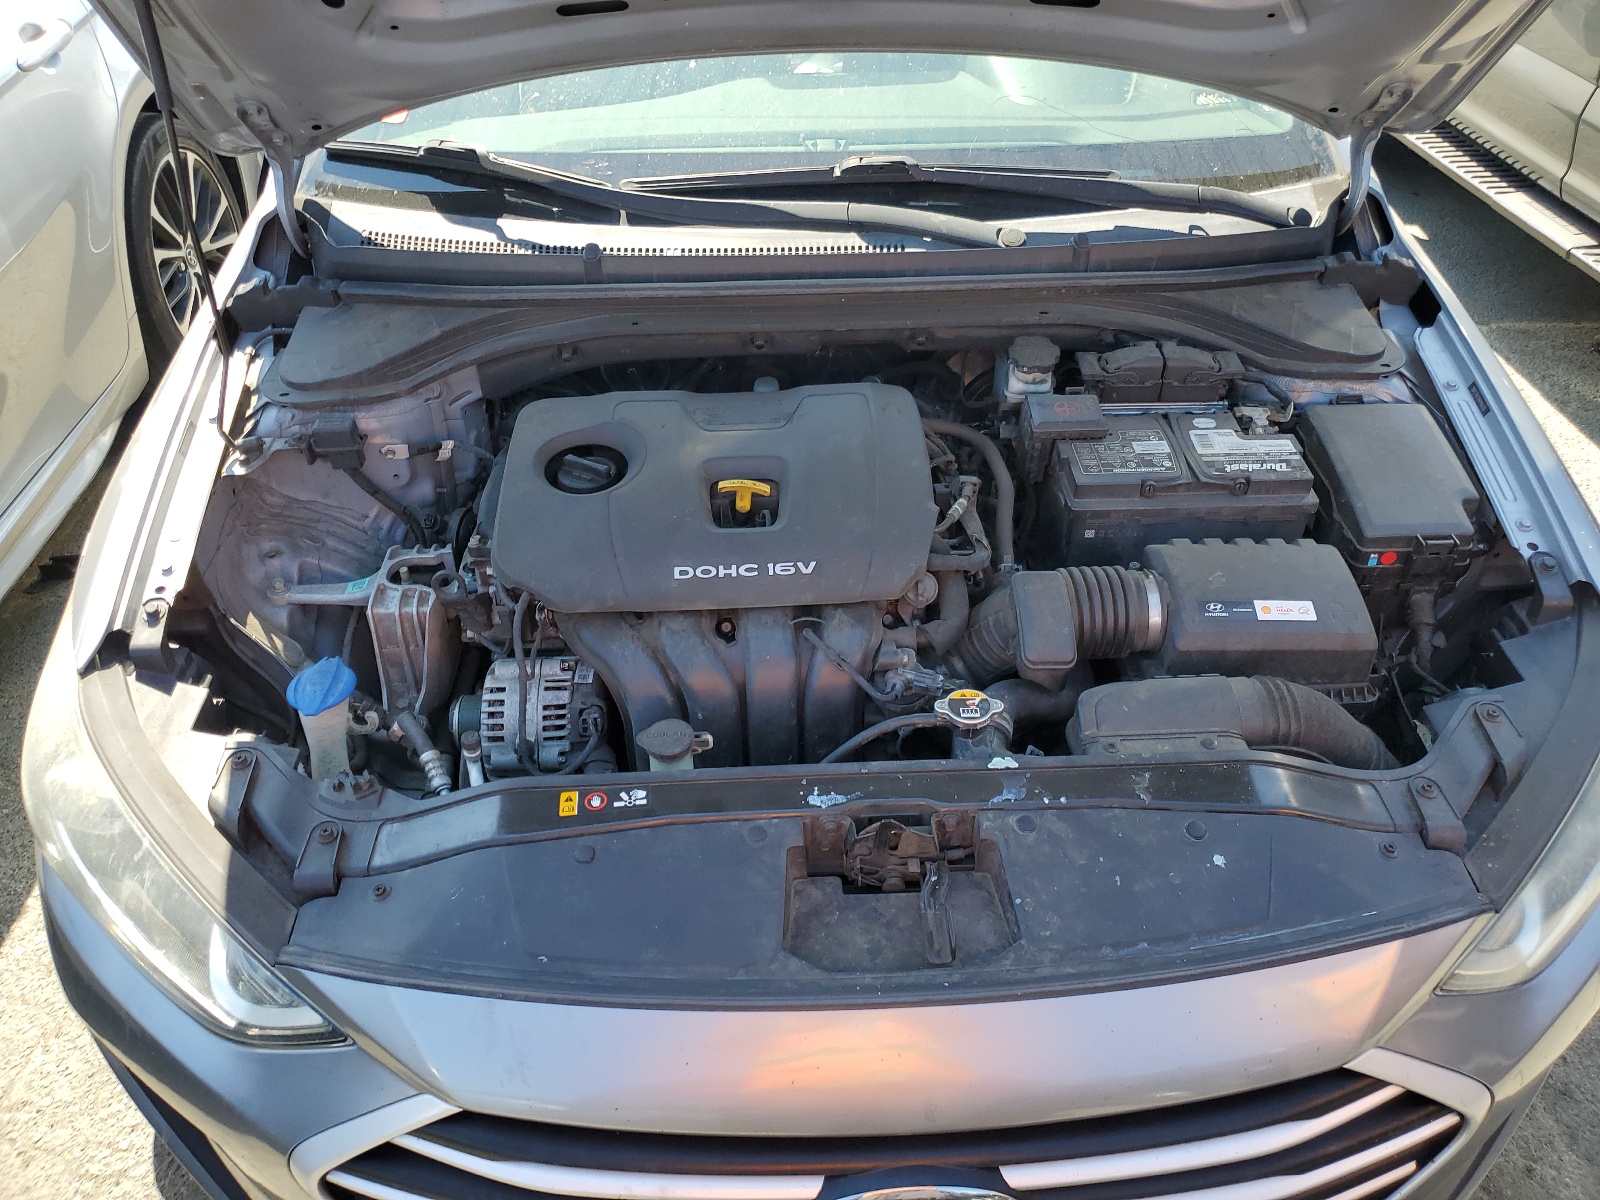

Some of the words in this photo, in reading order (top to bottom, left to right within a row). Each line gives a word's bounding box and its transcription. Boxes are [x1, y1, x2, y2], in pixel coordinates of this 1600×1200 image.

[1224, 462, 1292, 473] Duralast
[673, 563, 759, 579] DOHC
[766, 561, 818, 576] 16V
